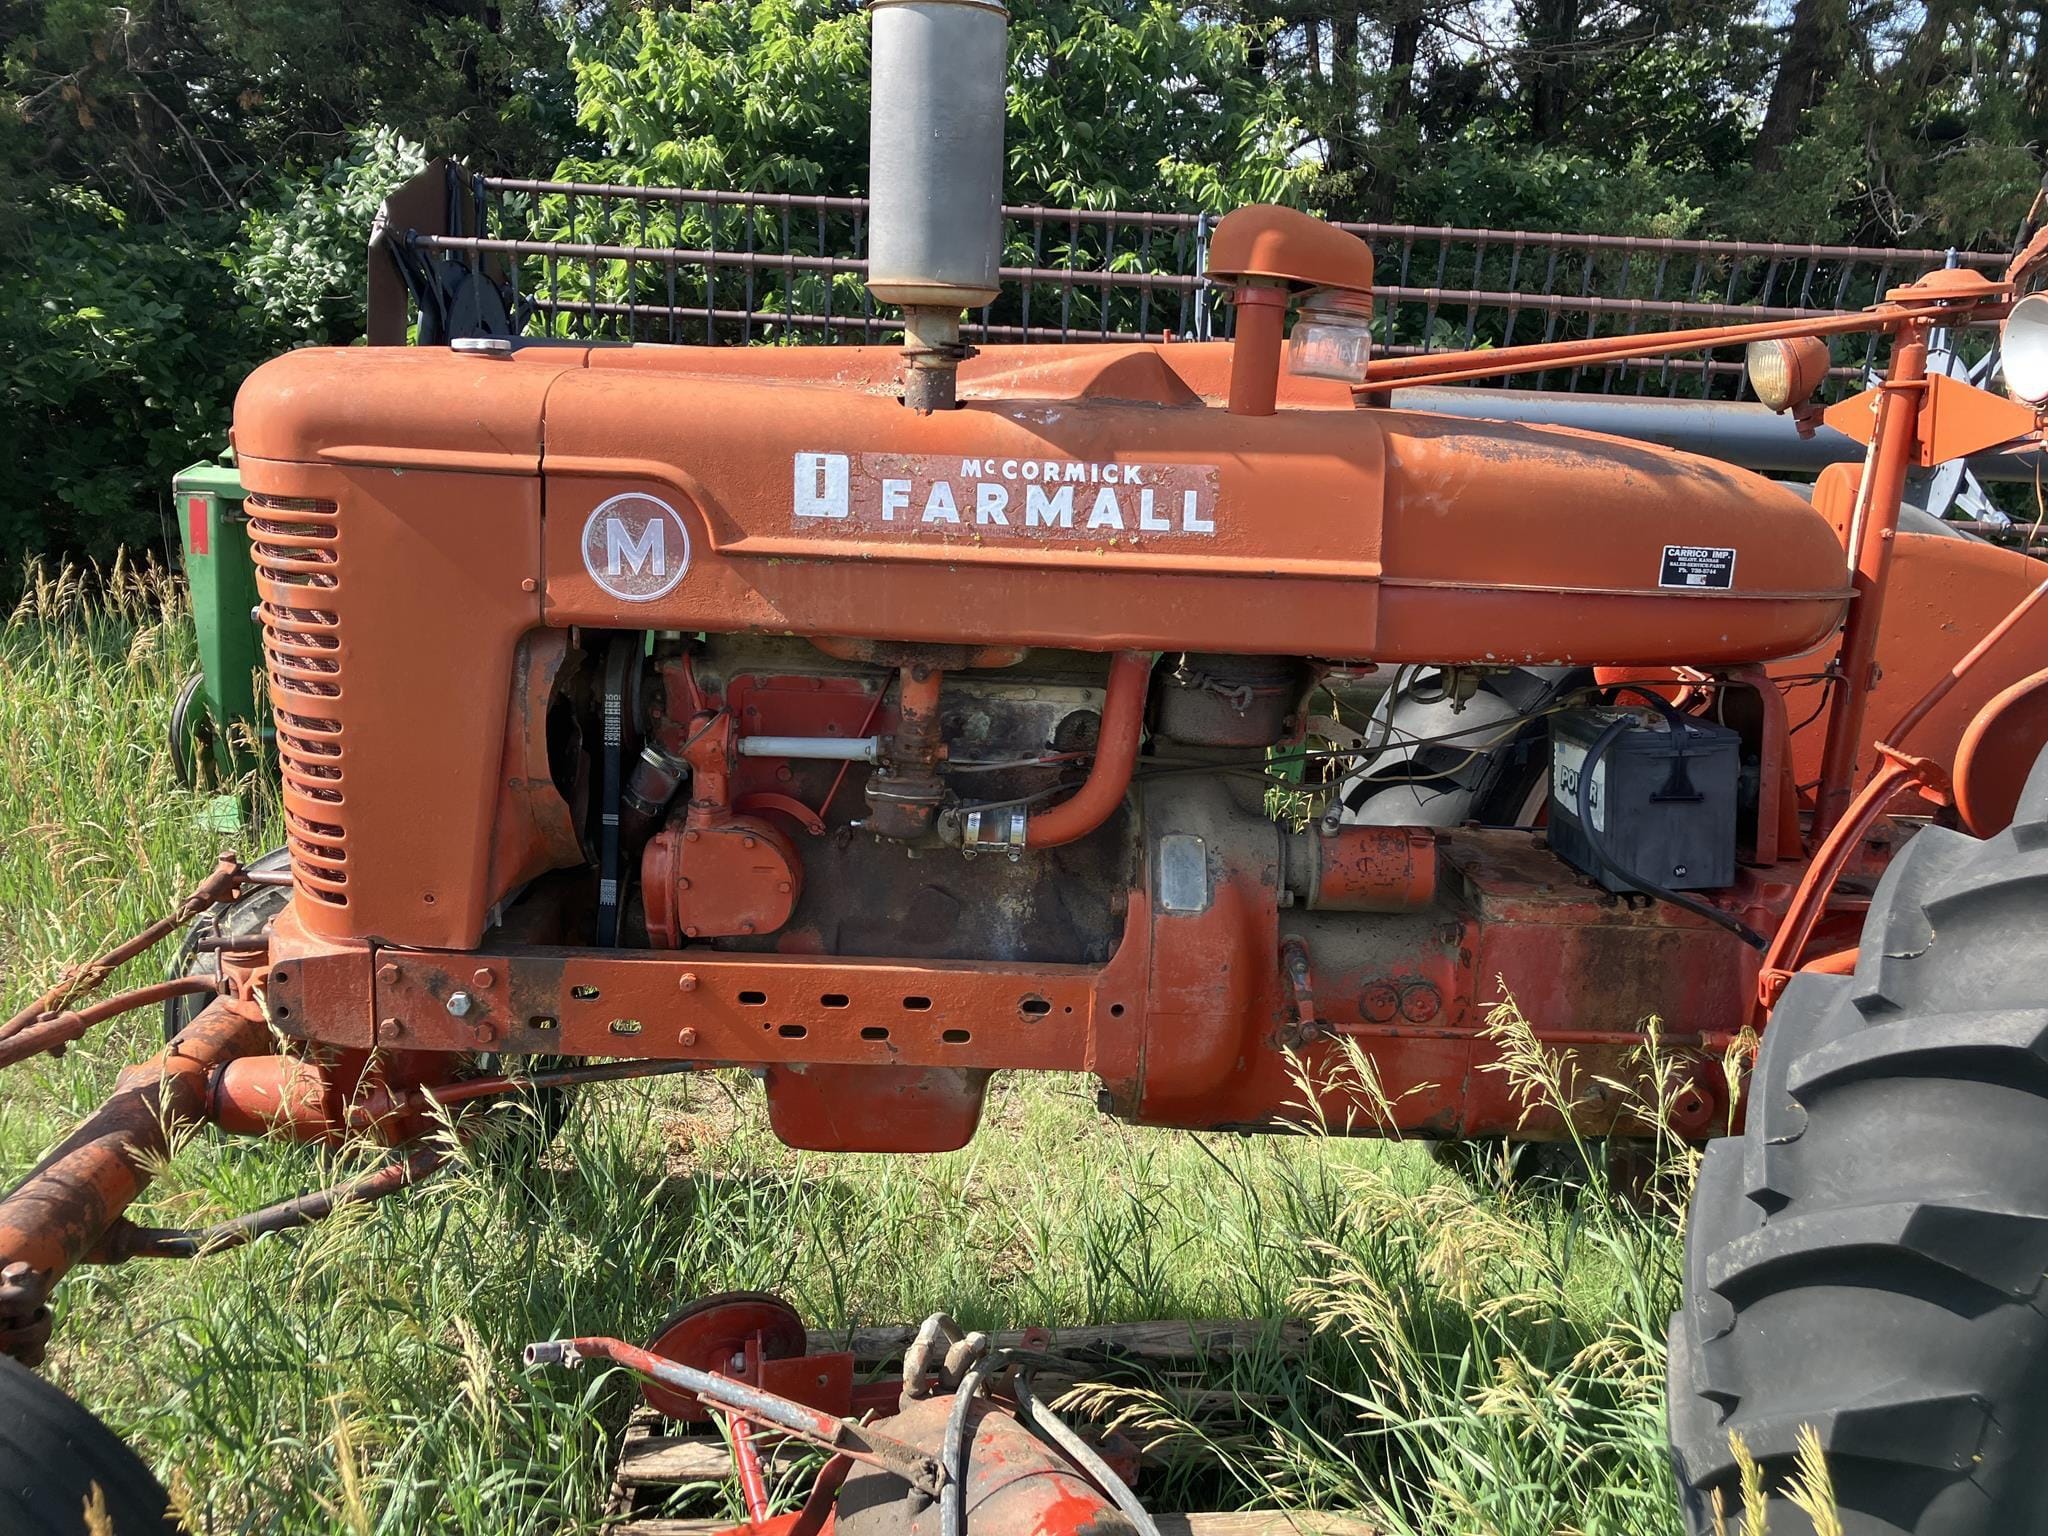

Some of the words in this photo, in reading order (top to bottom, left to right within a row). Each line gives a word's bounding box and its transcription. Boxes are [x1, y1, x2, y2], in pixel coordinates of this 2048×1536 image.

[881, 479, 1214, 533] FARMALL
[606, 518, 665, 576] M
[1667, 549, 1708, 558] CARRICO
[1712, 551, 1731, 559] IMP.
[1561, 765, 1598, 808] POR
